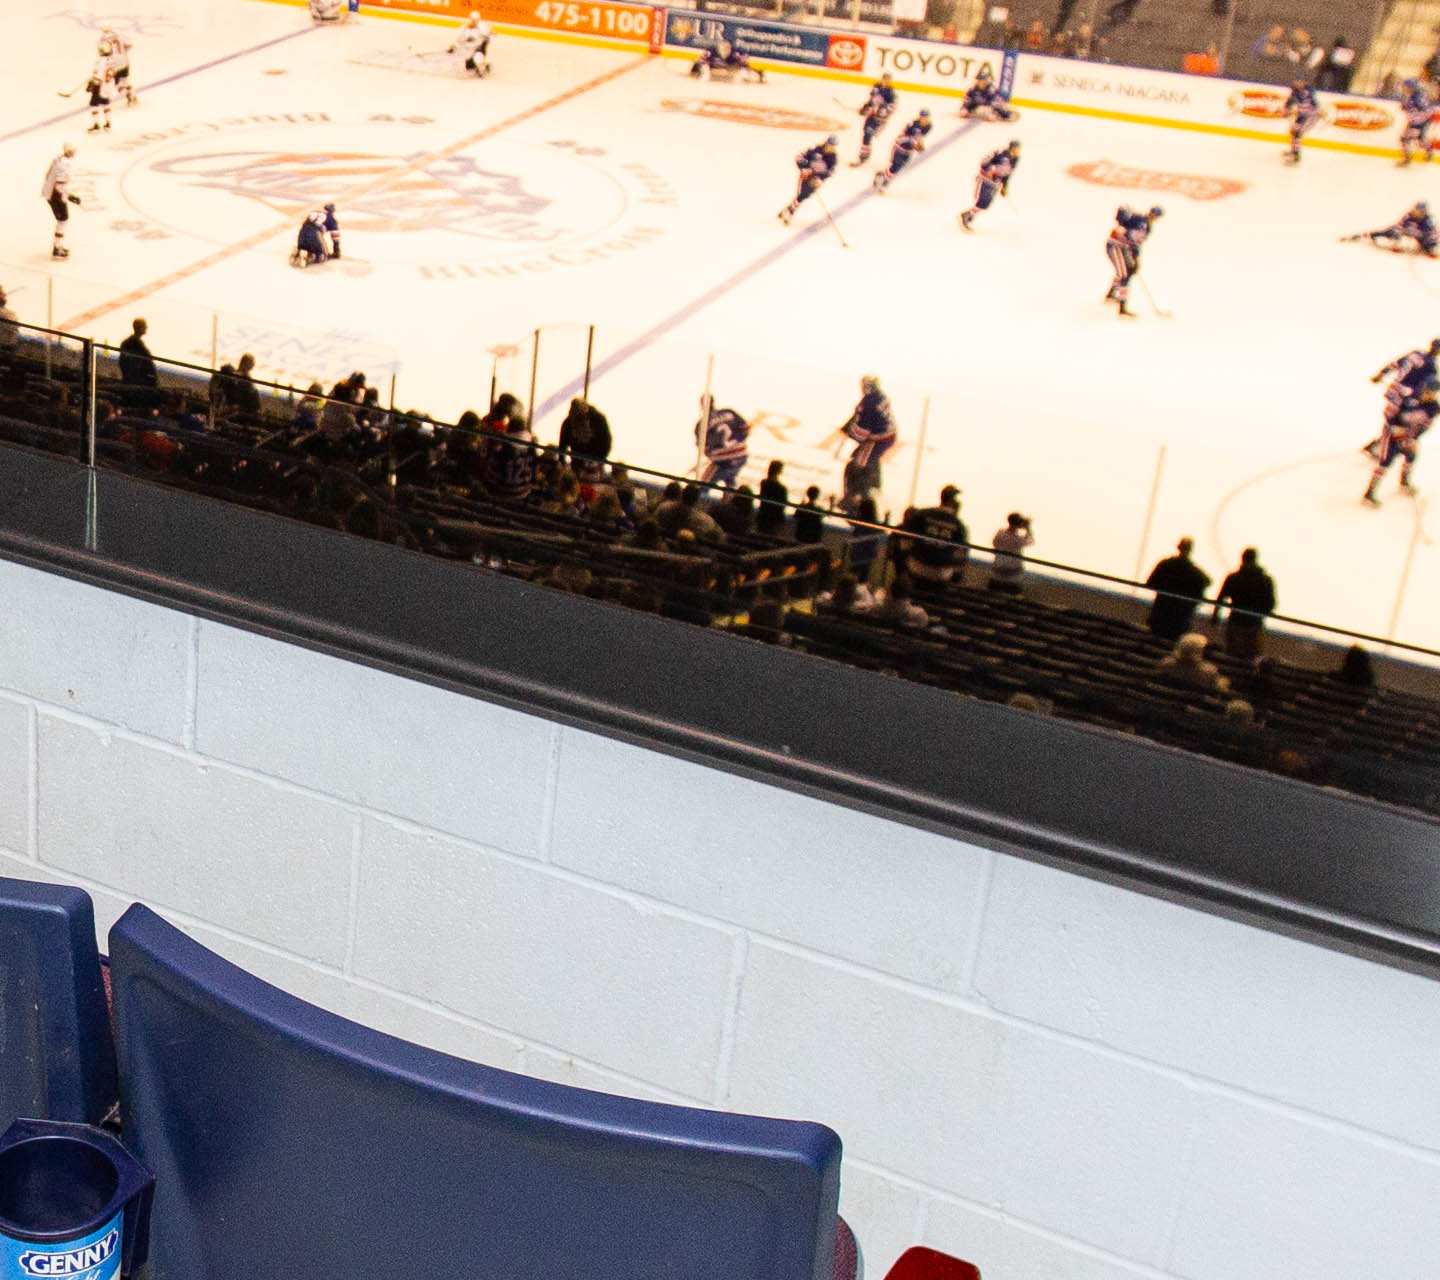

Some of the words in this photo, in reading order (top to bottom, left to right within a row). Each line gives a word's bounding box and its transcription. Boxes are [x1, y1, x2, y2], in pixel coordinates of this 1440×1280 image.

[535, 1, 649, 35] 475-1100
[877, 47, 994, 80] TOYOTA
[1053, 73, 1113, 93] SENECA
[1118, 84, 1190, 105] NIAGARA
[28, 1234, 113, 1274] GENNY
